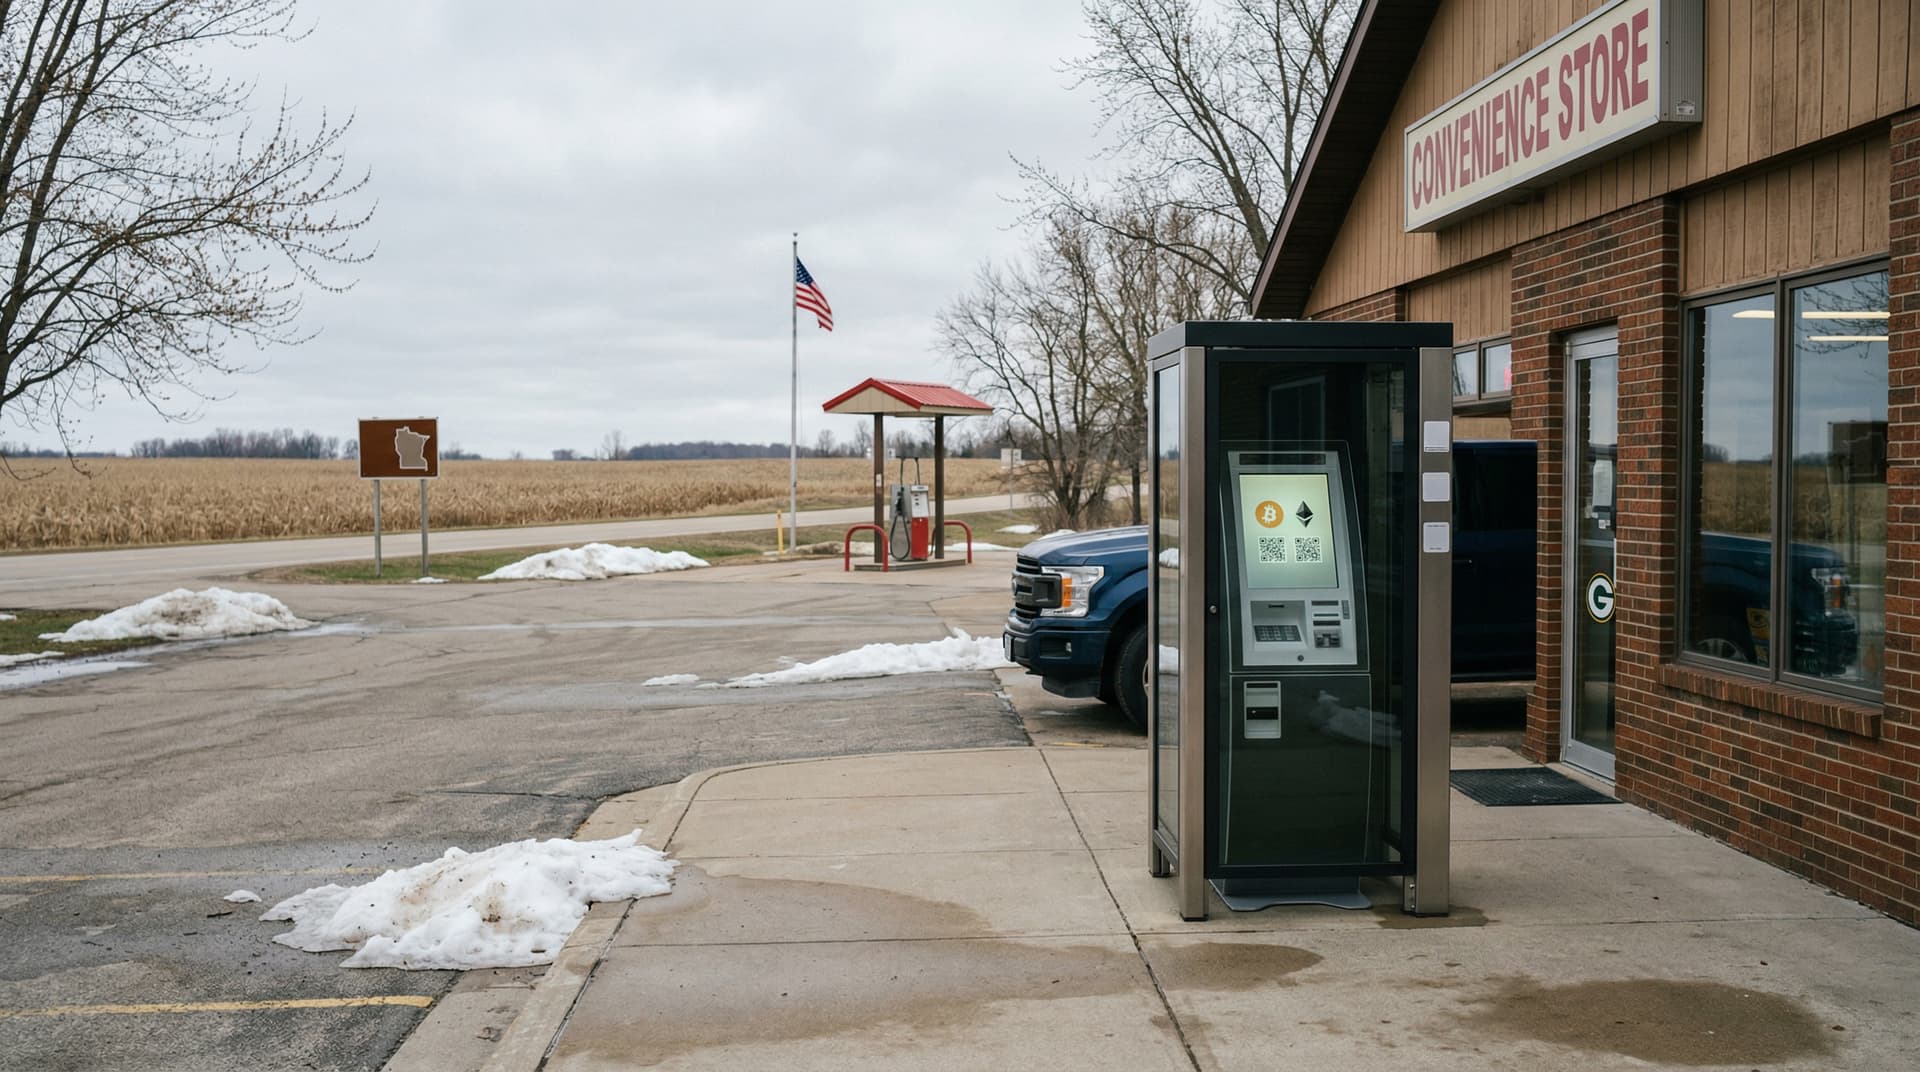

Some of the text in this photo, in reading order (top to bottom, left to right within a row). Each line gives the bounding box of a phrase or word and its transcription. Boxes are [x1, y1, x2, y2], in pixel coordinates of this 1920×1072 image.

[1412, 8, 1649, 210] CONVENIENCE STORE
[1588, 577, 1615, 619] G
